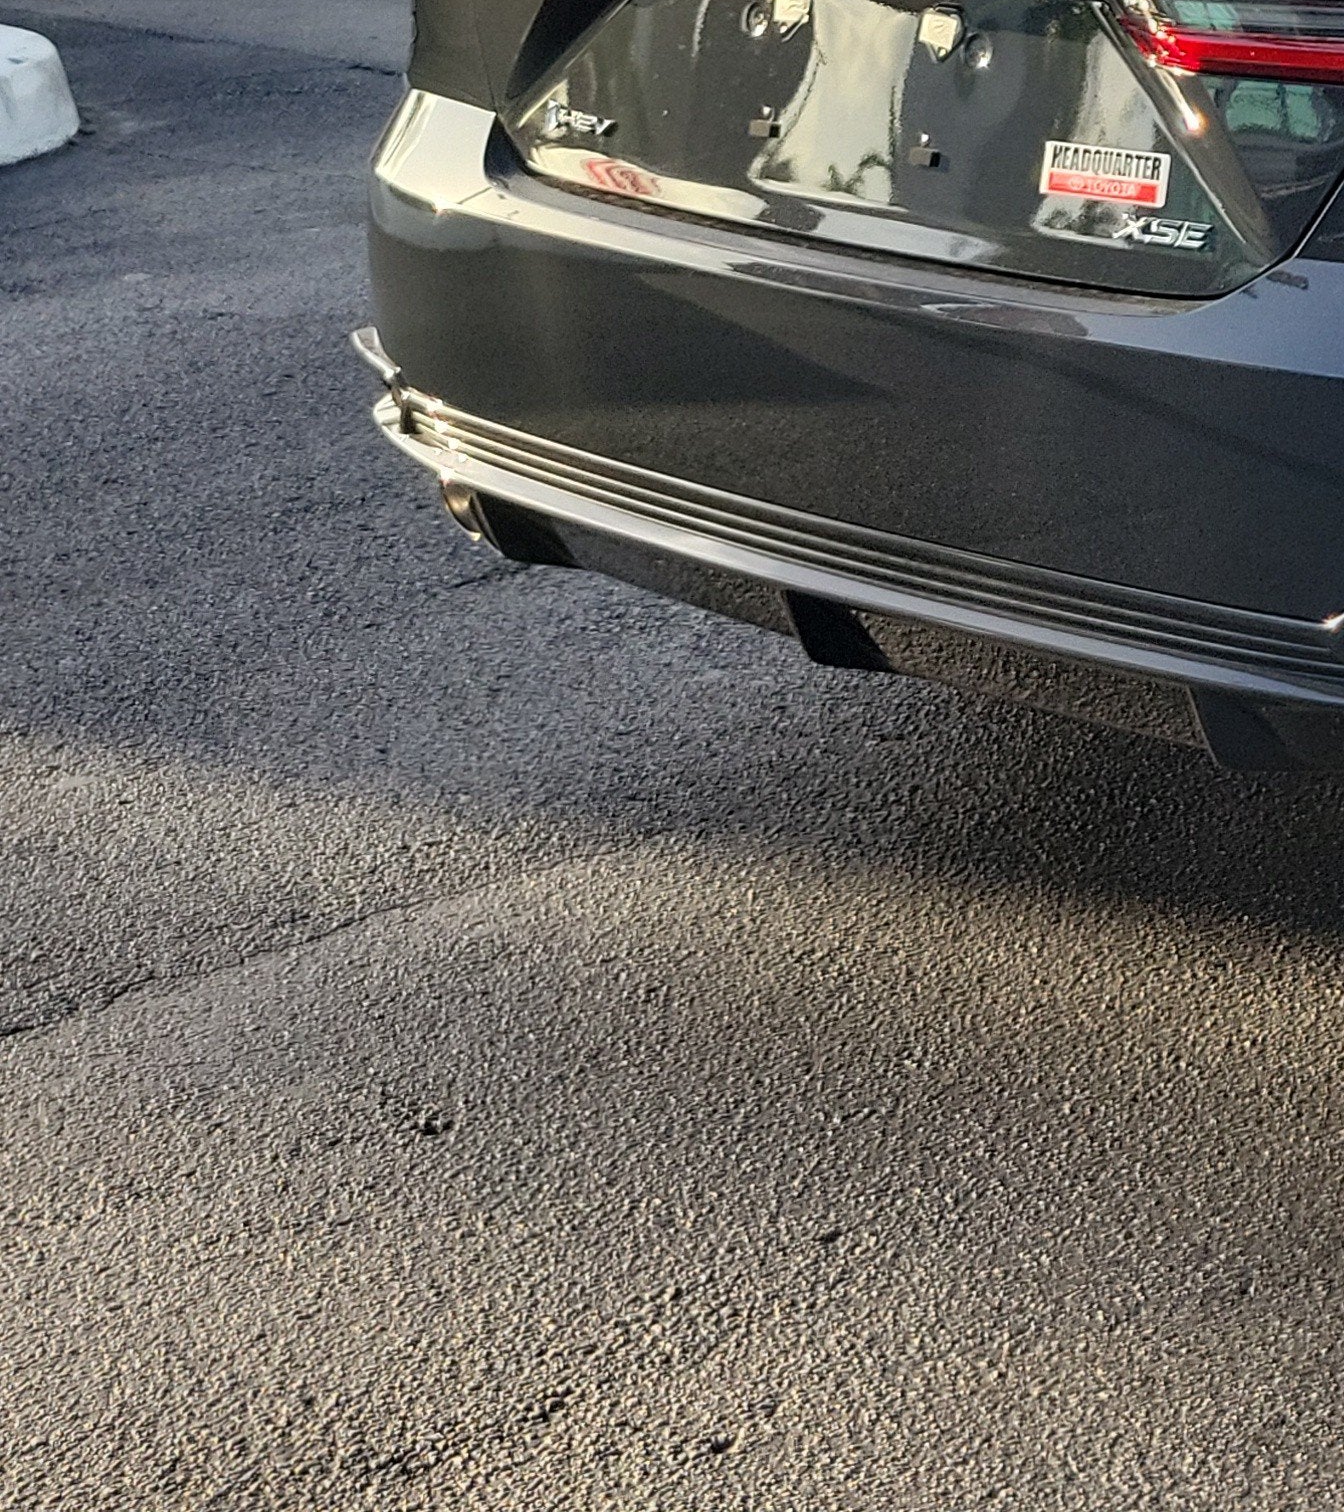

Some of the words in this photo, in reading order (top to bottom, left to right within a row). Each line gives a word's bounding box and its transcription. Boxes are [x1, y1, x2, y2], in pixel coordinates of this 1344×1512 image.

[1050, 144, 1162, 181] HEADQUARTER
[1086, 179, 1138, 196] TOYOTA
[1112, 212, 1215, 250] XSE
